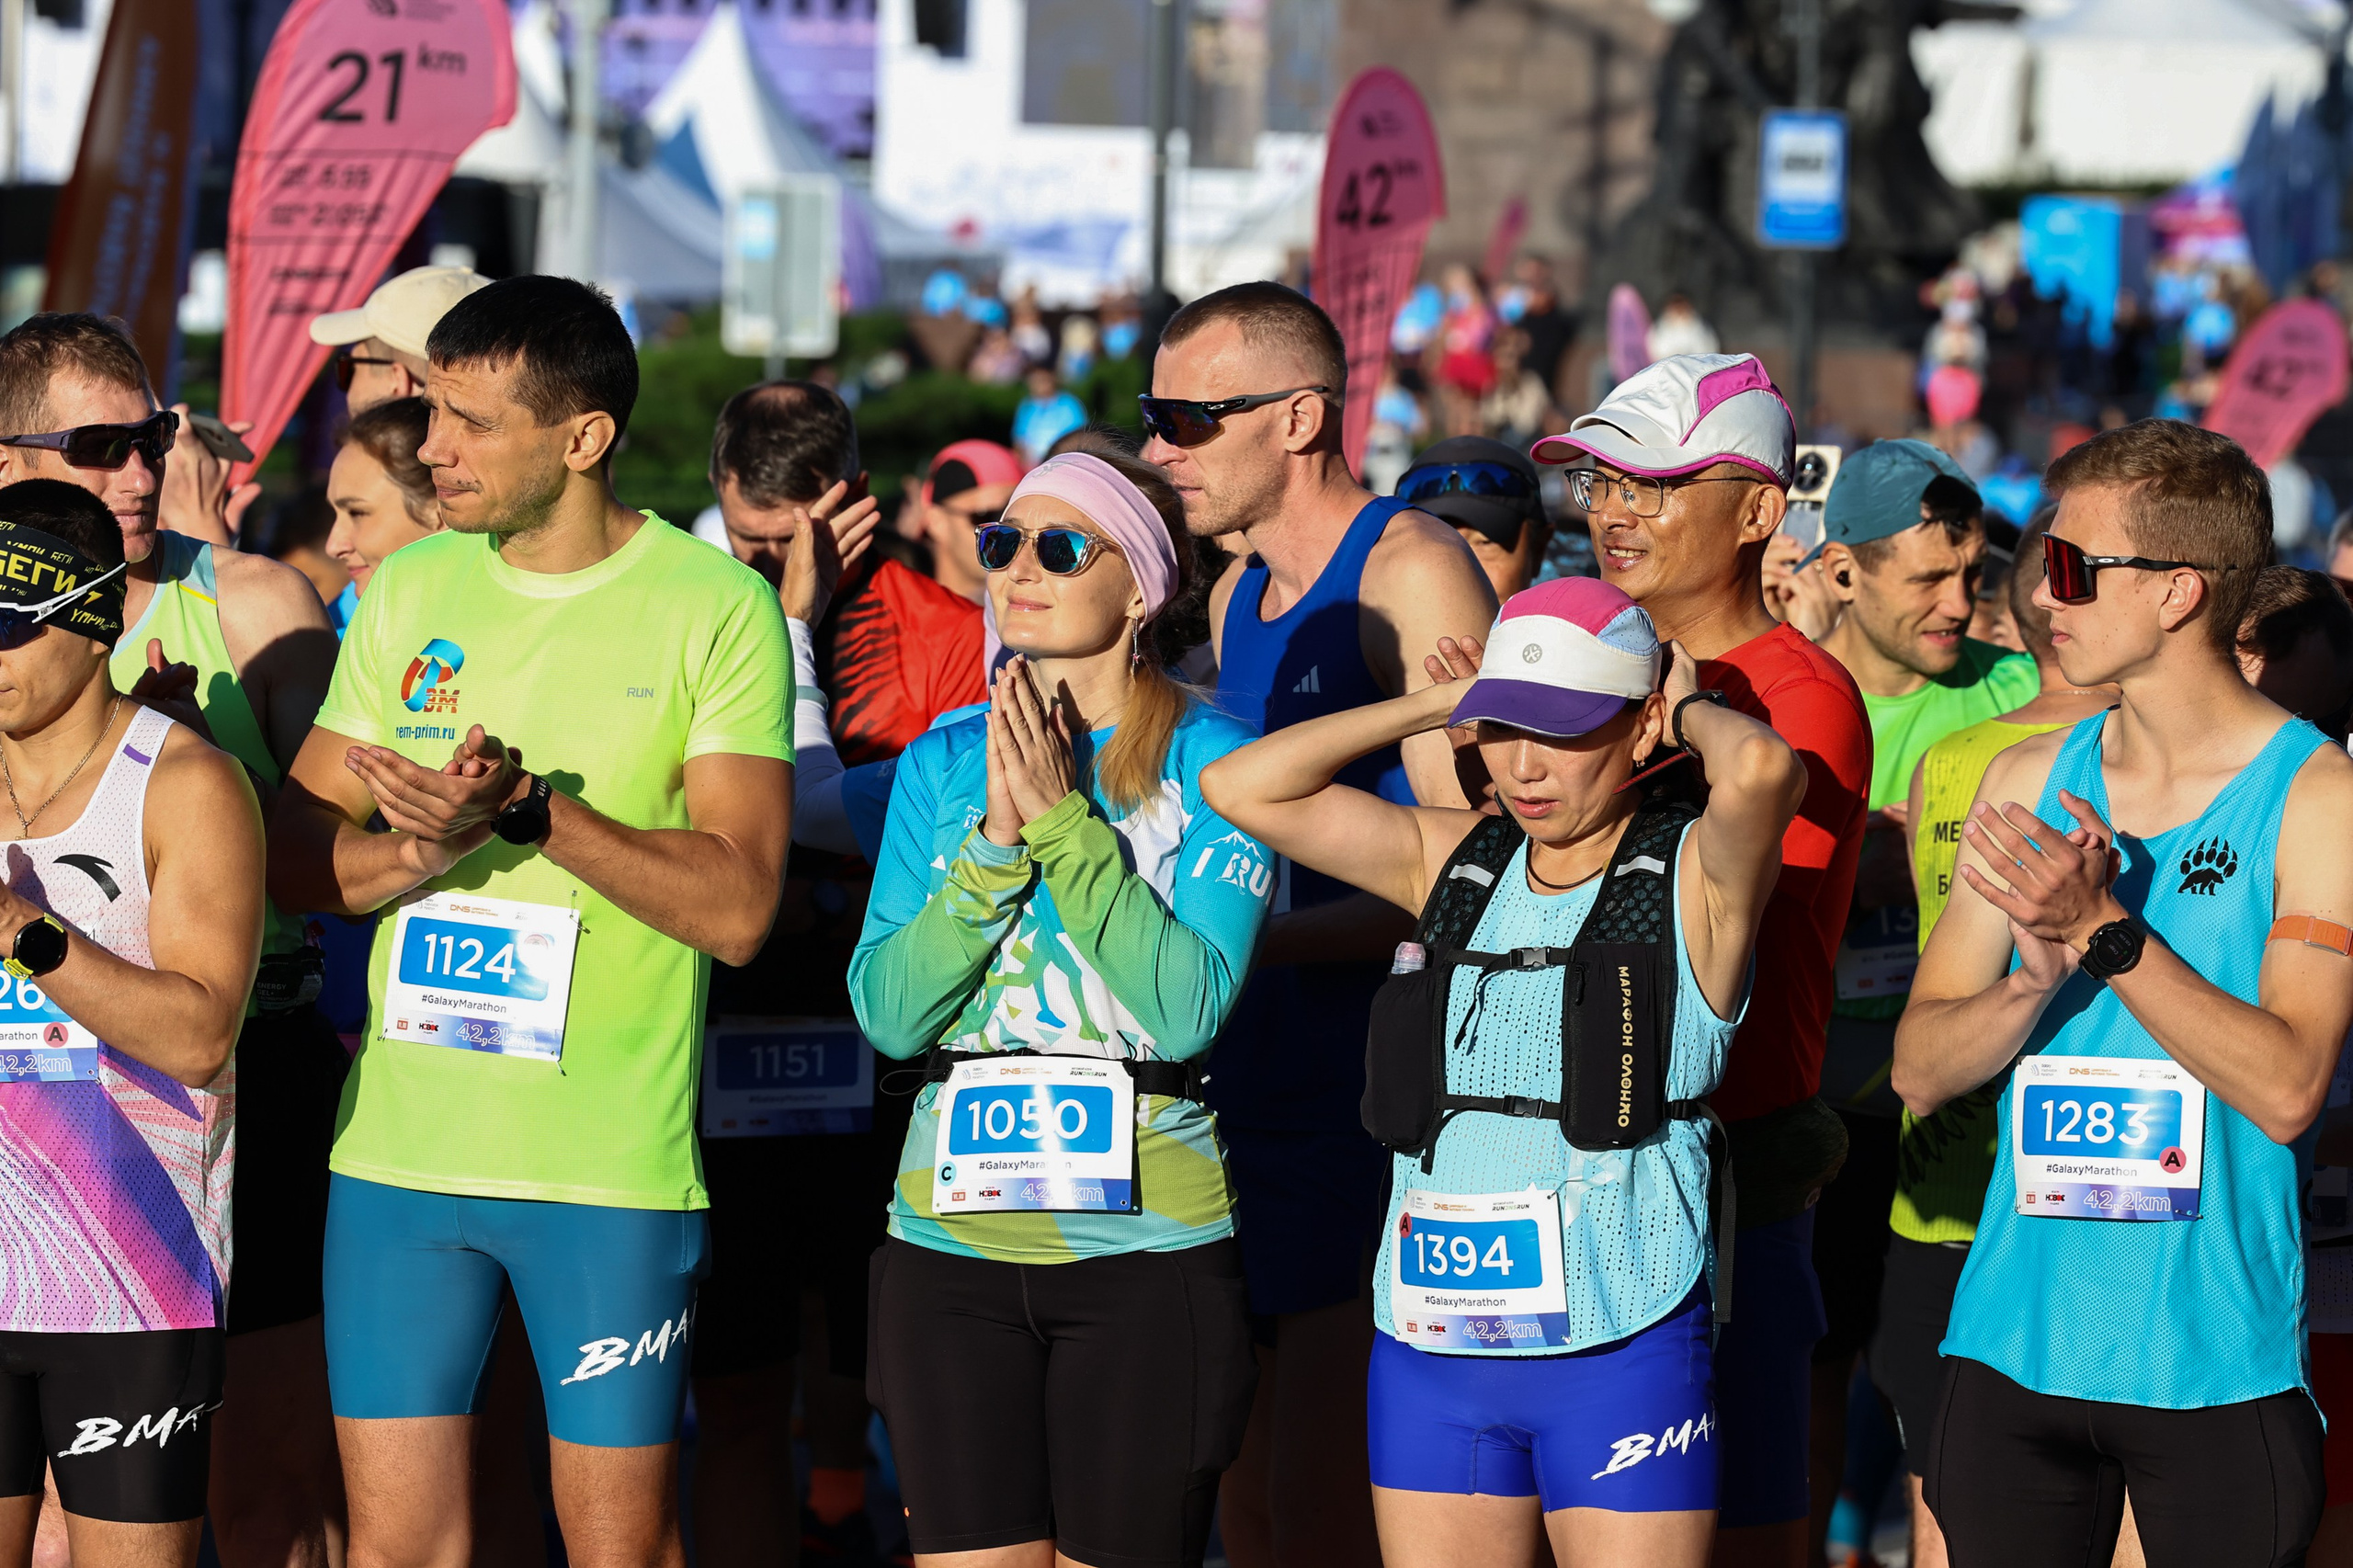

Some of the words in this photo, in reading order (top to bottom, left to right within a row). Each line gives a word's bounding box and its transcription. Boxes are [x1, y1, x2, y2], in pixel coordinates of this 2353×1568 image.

[319, 50, 405, 123] 21
[417, 44, 466, 74] km
[1336, 163, 1392, 230] 42
[627, 687, 654, 699] RUN
[395, 724, 456, 740] rem-prim.ru
[1191, 847, 1215, 878] I
[1215, 852, 1275, 905] RU
[1938, 874, 1951, 895] Б
[449, 903, 471, 913] DNS
[424, 933, 517, 983] 1124
[422, 994, 506, 1013] #GalaxyMarathon
[1619, 966, 1633, 1047] МАРАФОН
[48, 1027, 63, 1041] A
[456, 1023, 536, 1049] 42,2km
[750, 1044, 825, 1079] 1151
[2069, 1067, 2091, 1075] DNS
[968, 1098, 1087, 1141] 1050
[2041, 1100, 2150, 1146] 1283
[979, 1160, 1072, 1171] #GalaxyMaran
[2164, 1152, 2181, 1166] A
[941, 1165, 952, 1181] C
[2046, 1164, 2137, 1176] #GalaxyMarathon
[1020, 1183, 1105, 1202] 42km
[2084, 1190, 2171, 1213] 42,2km
[1434, 1202, 1449, 1210] DNS
[1401, 1221, 1409, 1233] A
[1414, 1233, 1514, 1277] 1394
[1425, 1296, 1506, 1307] #GalaxyMarathon
[560, 1298, 697, 1386] BMA
[1463, 1321, 1542, 1343] 42,2km
[57, 1401, 223, 1458] BMA
[1590, 1407, 1715, 1481] BMA
